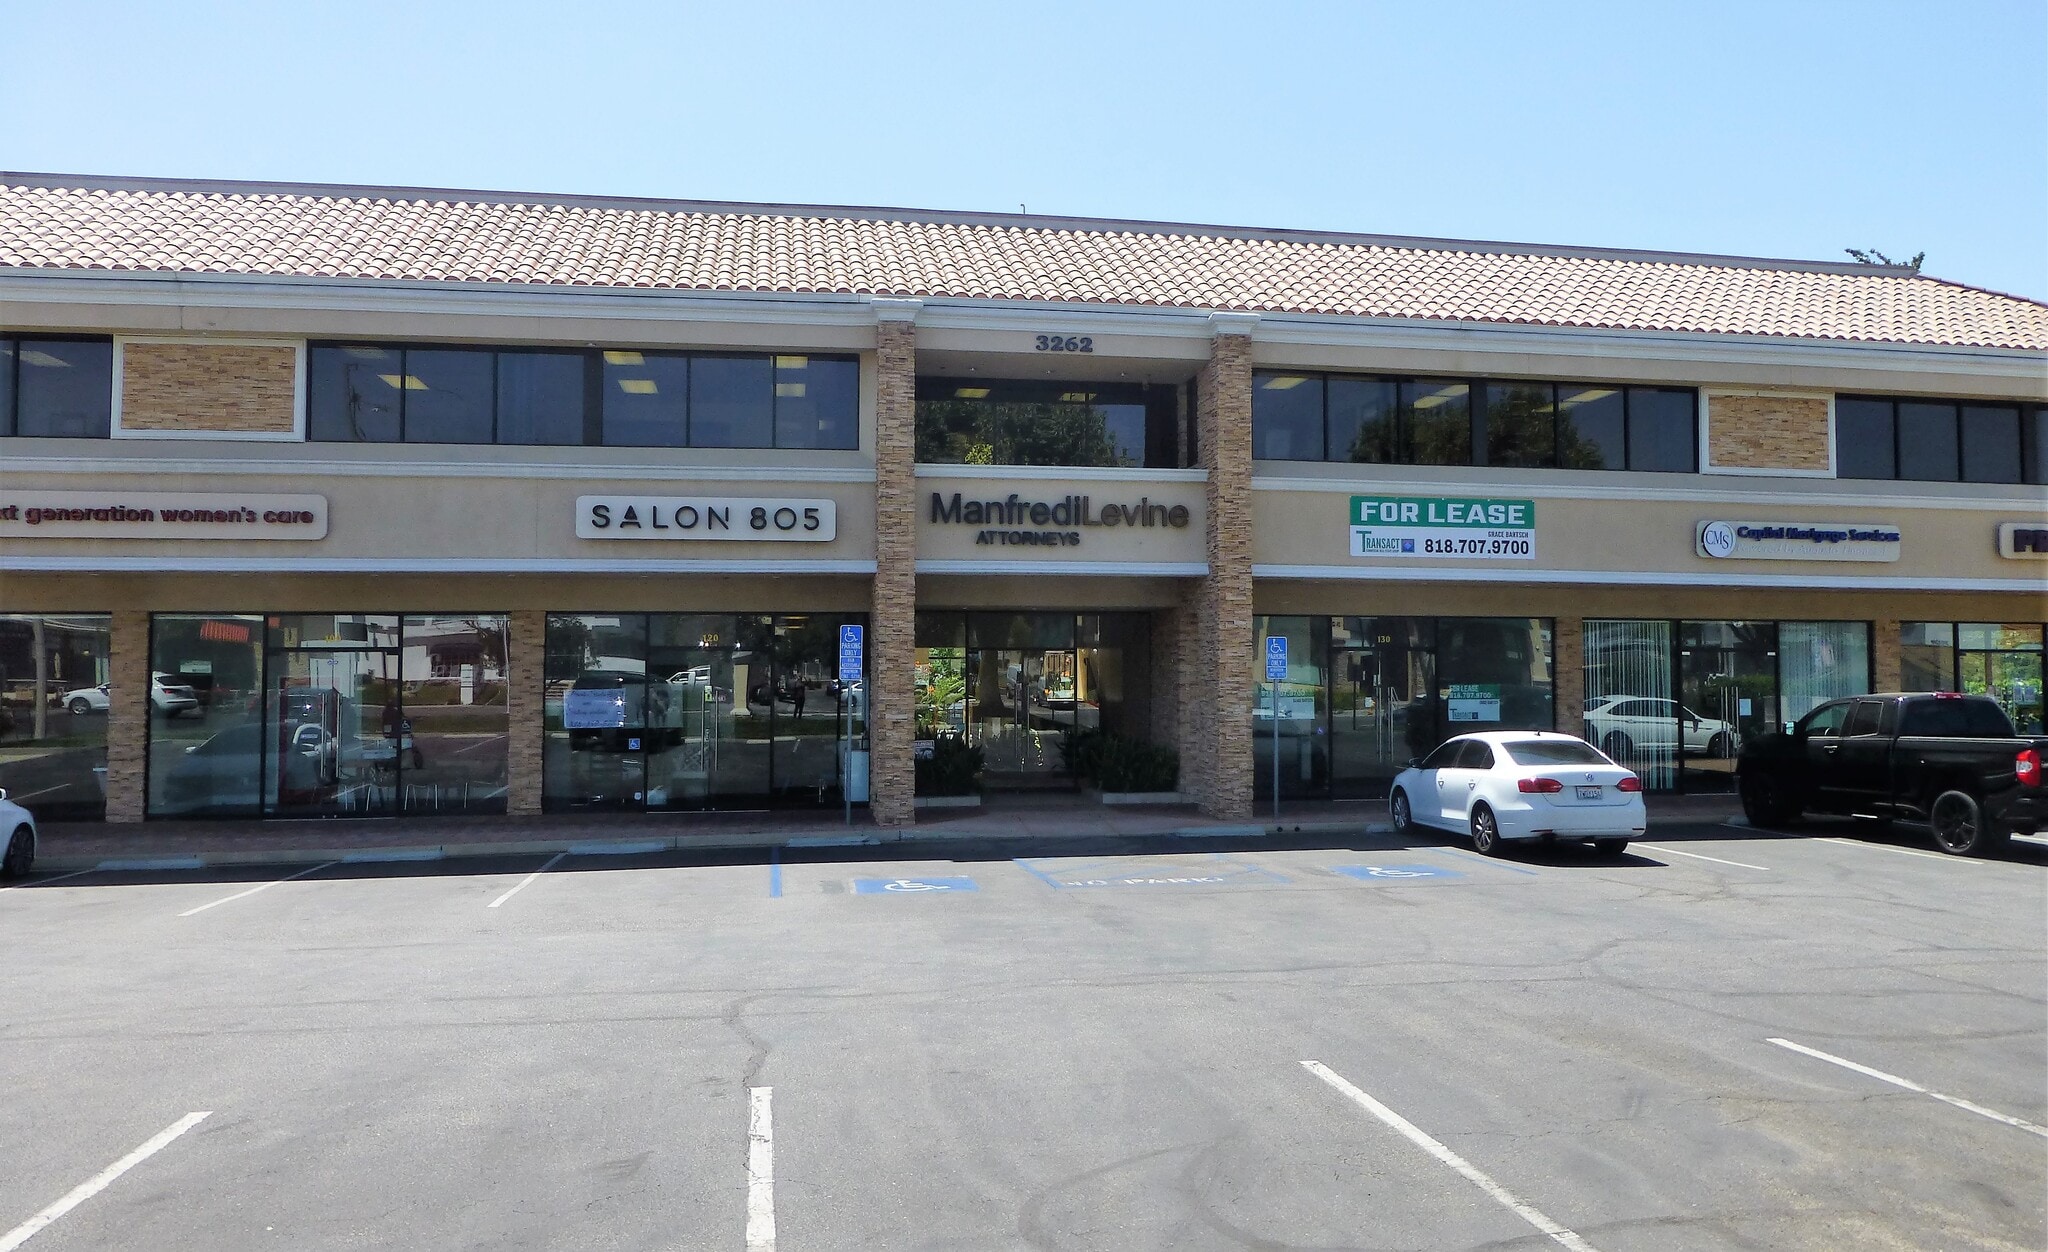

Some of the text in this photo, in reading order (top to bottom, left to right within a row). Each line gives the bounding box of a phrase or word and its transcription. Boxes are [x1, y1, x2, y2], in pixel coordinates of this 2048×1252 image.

[1035, 335, 1093, 352] 3262
[25, 504, 154, 525] generation
[160, 505, 257, 524] women's
[263, 509, 314, 524] care
[591, 504, 820, 530] SALON 805
[1360, 501, 1525, 525] FOR LEASE
[976, 530, 1080, 546] ATTORNEYS
[1705, 530, 1729, 549] CMS
[1737, 526, 1900, 543] Capital Mortgage Services
[1424, 538, 1529, 555] 818.707.9700
[703, 634, 719, 642] 120
[1377, 635, 1391, 643] 130
